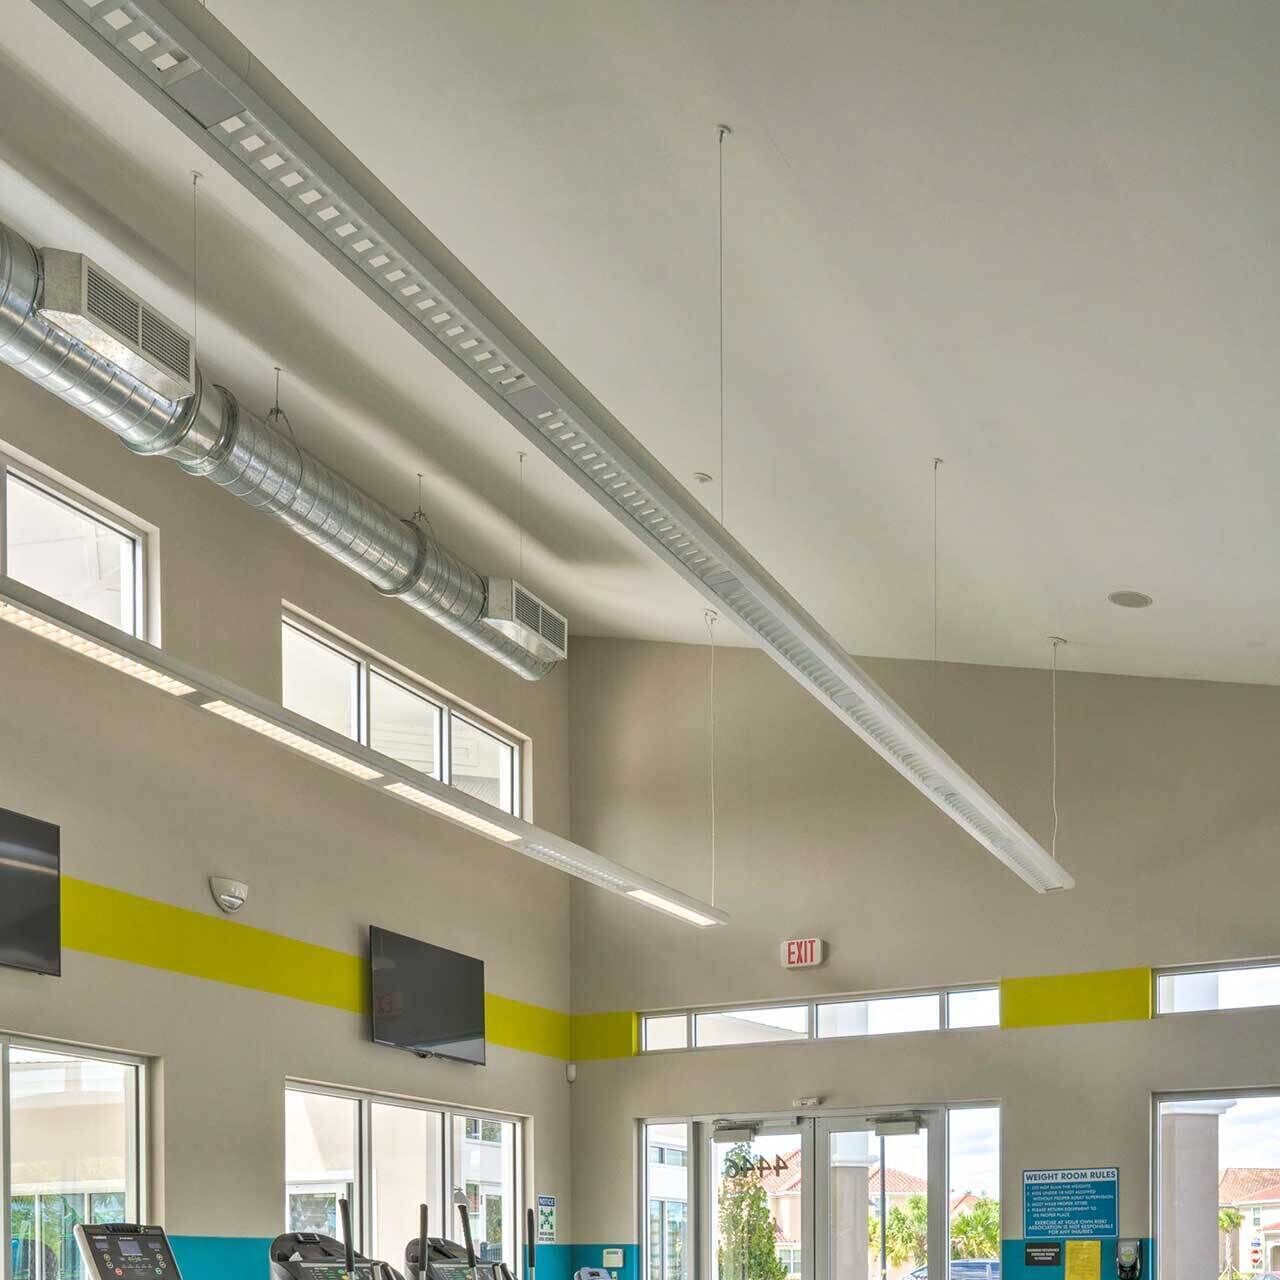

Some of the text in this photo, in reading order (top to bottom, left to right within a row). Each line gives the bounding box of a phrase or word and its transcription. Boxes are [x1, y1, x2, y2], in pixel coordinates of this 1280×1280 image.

[788, 940, 816, 964] EXIT
[1025, 1171, 1116, 1181] WEIGHT ROOM RULES
